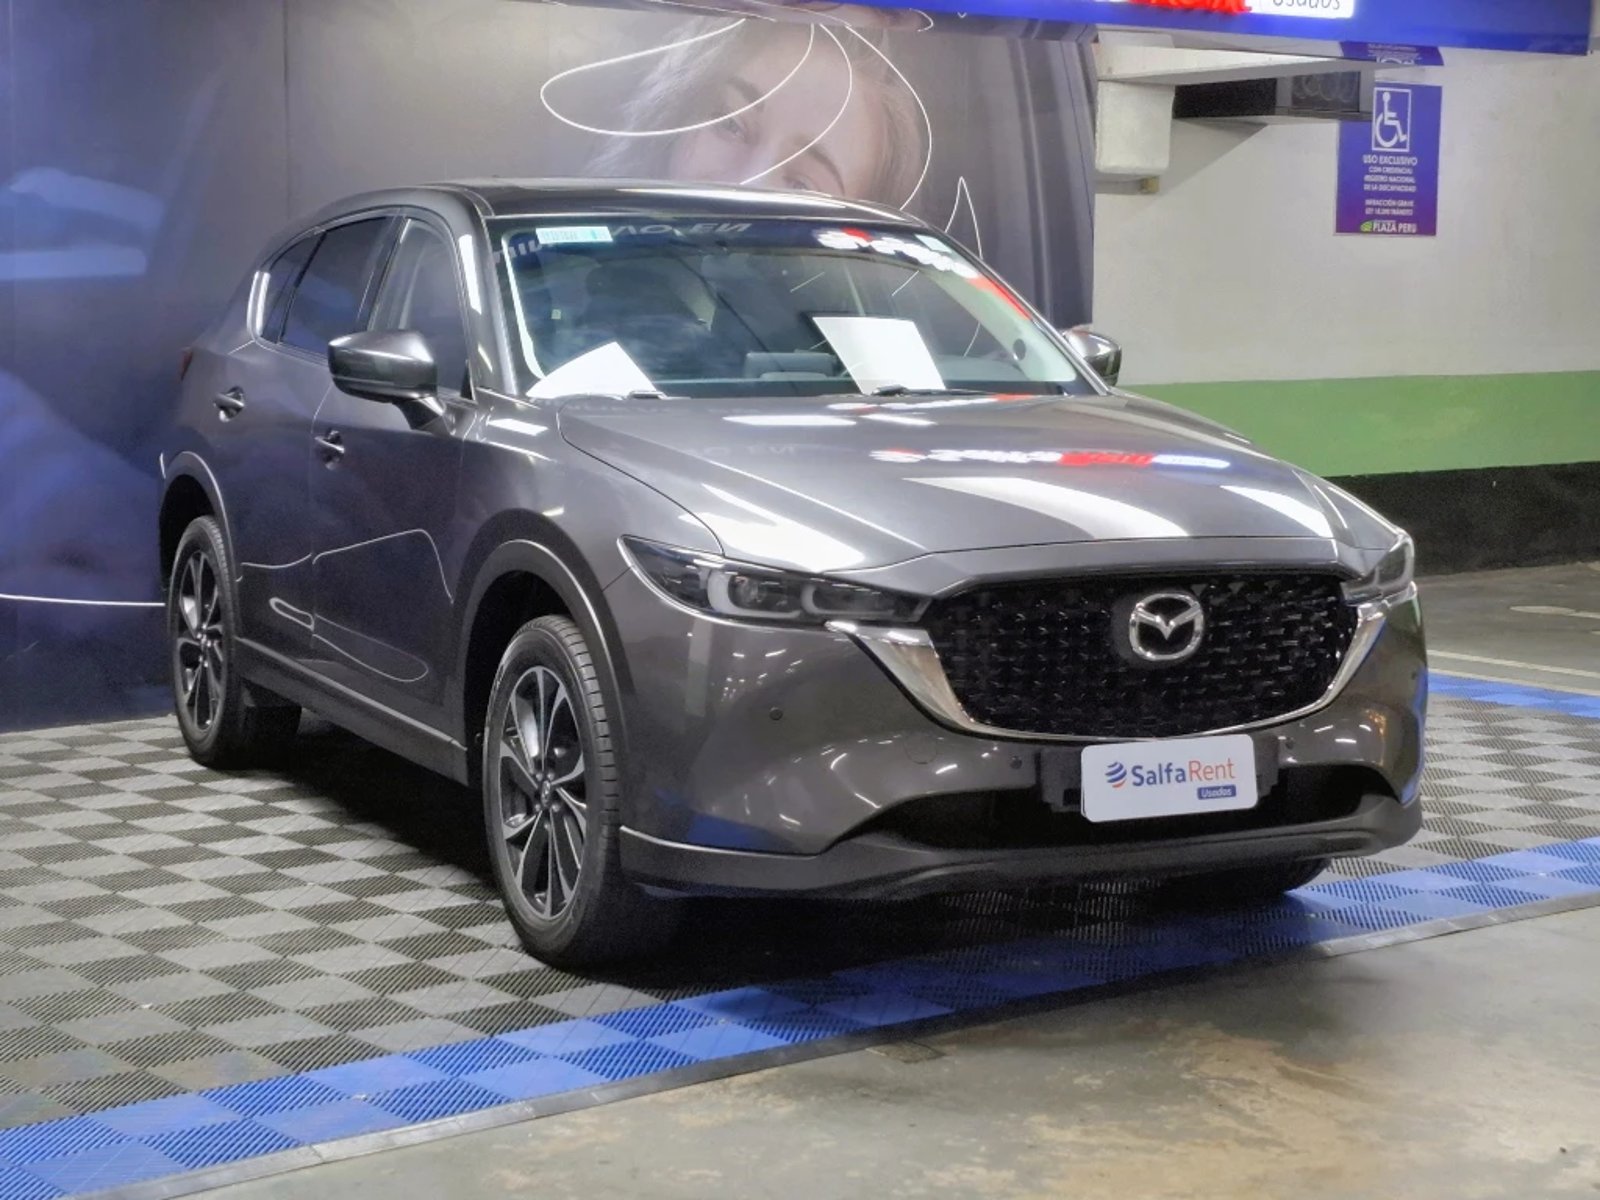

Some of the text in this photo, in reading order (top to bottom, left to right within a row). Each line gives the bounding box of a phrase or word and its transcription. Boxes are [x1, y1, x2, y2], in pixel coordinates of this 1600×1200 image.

[1363, 155, 1418, 166] USO EXCLUSIVO
[1373, 221, 1397, 232] PLAZA
[1131, 758, 1236, 787] SalfaRent
[1201, 786, 1232, 798] Usados
